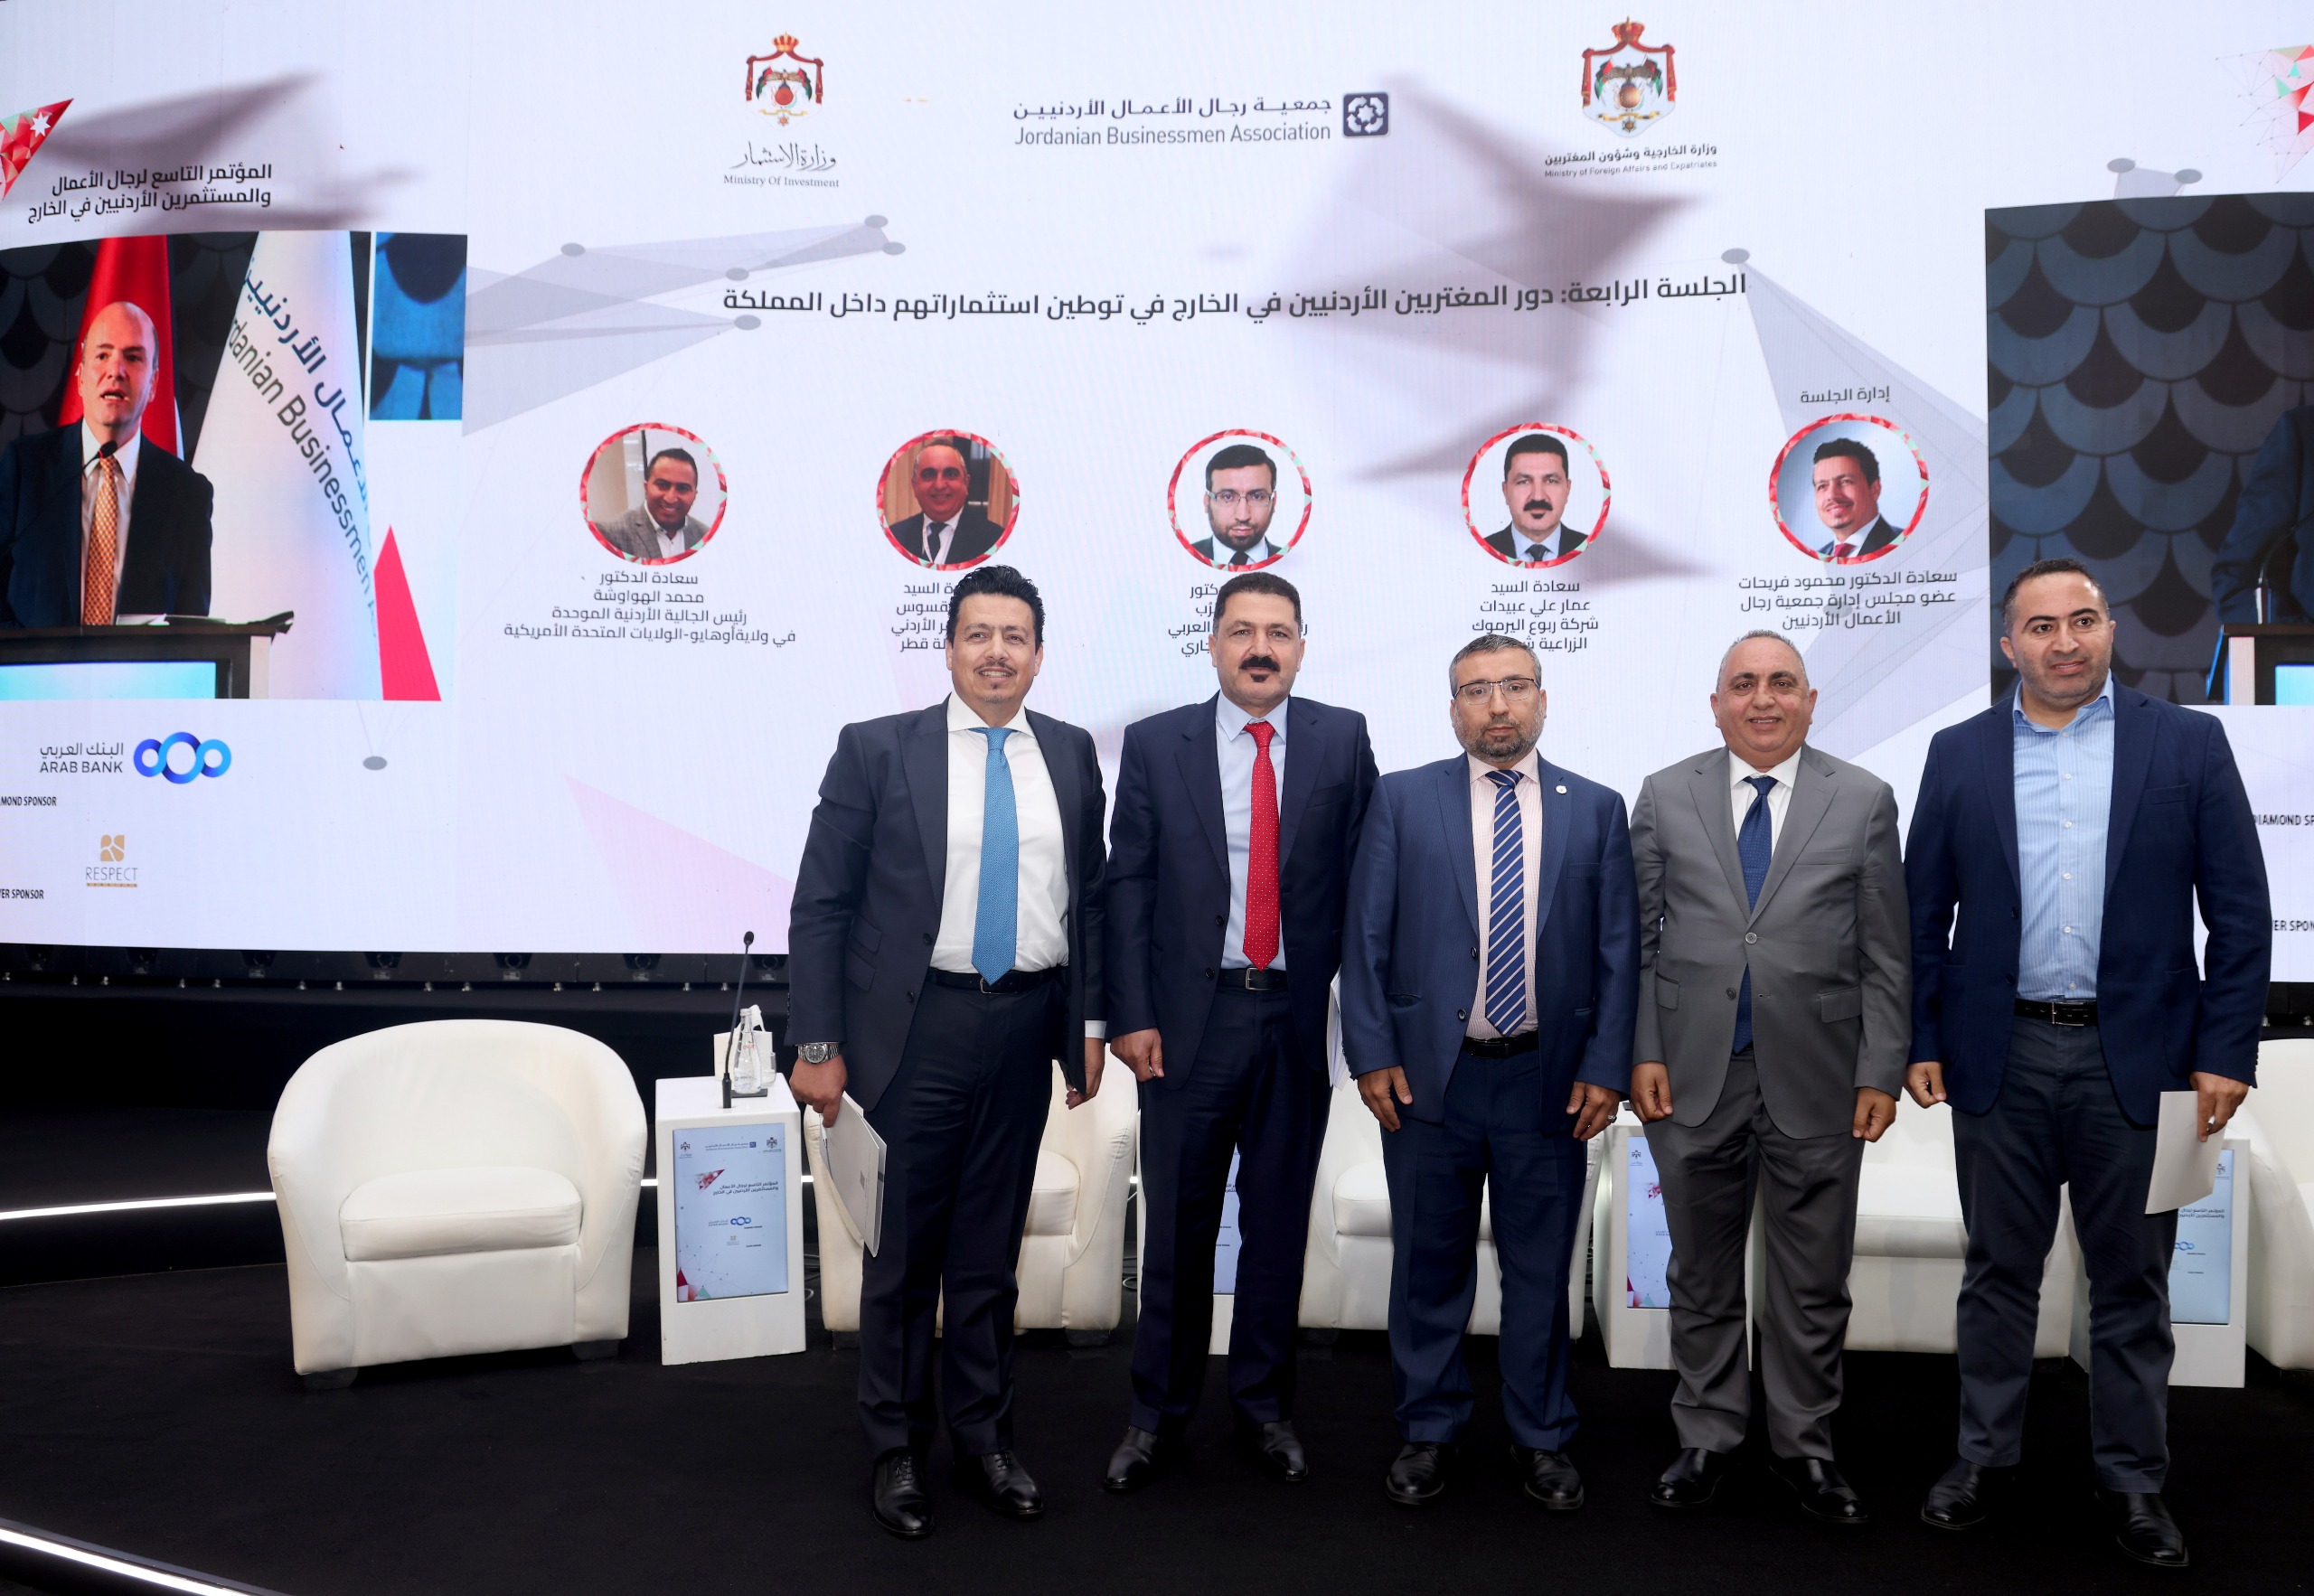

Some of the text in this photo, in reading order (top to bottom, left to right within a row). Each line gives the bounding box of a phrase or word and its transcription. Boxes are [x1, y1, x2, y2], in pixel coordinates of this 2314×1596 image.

[1013, 97, 1331, 119] جمعية رجال الأعمال الأردنيين
[1015, 122, 1331, 145] Jordanian Businessmen Association
[796, 143, 836, 171] وزارة
[1546, 144, 1717, 165] وزارة الخارجية وشؤون المغتربين
[1545, 160, 1717, 178] Ministry of Foreign Affairs and Expatriates
[52, 162, 272, 196] المؤتمر التاسع لرجال الأعمال
[724, 174, 839, 187] Ministry Of Investment
[28, 187, 271, 223] والمستثمرين الأردنيين في الخارج
[723, 273, 1745, 324] الجلسة الرابعة: دور المغتربين الأردنيين في الخارج في توطين استثماراتهم داخل المملكة
[1801, 385, 1890, 405] إدارة الجلسة
[277, 395, 371, 595] Businessmen
[600, 571, 698, 586] سعادة الدكتور
[1738, 571, 1958, 591] سعادة الدكتور محمود فريحات
[594, 587, 703, 605] محمد الهواوشة
[904, 582, 939, 596] السيد
[1190, 584, 1218, 598] كتور
[1491, 580, 1580, 596] سعادة السيد
[897, 601, 949, 615] قسوس
[1481, 598, 1590, 617] عمار علي عبيدات
[1741, 590, 1956, 612] عضو مجلس إدارة جمعية رجال
[552, 605, 747, 625] رئيس الجالية الأردنية الموحدة
[1783, 609, 1901, 630] الأعمال الأردنيين
[504, 623, 568, 640] الأمريكية
[572, 625, 626, 638] المتحدة
[891, 617, 935, 636] الأردني
[1168, 621, 1209, 639] العربي
[1472, 616, 1598, 635] شركة ربوع اليرموك
[773, 631, 795, 647] في
[899, 638, 927, 652] قطر
[1538, 637, 1587, 652] الزراعية
[40, 742, 124, 759] البنك العربي
[40, 761, 123, 774] ARAB BANK
[0, 796, 57, 806] MOND SPONSOR
[85, 866, 138, 881] RESPECT
[12, 888, 44, 899] SPONSOR
